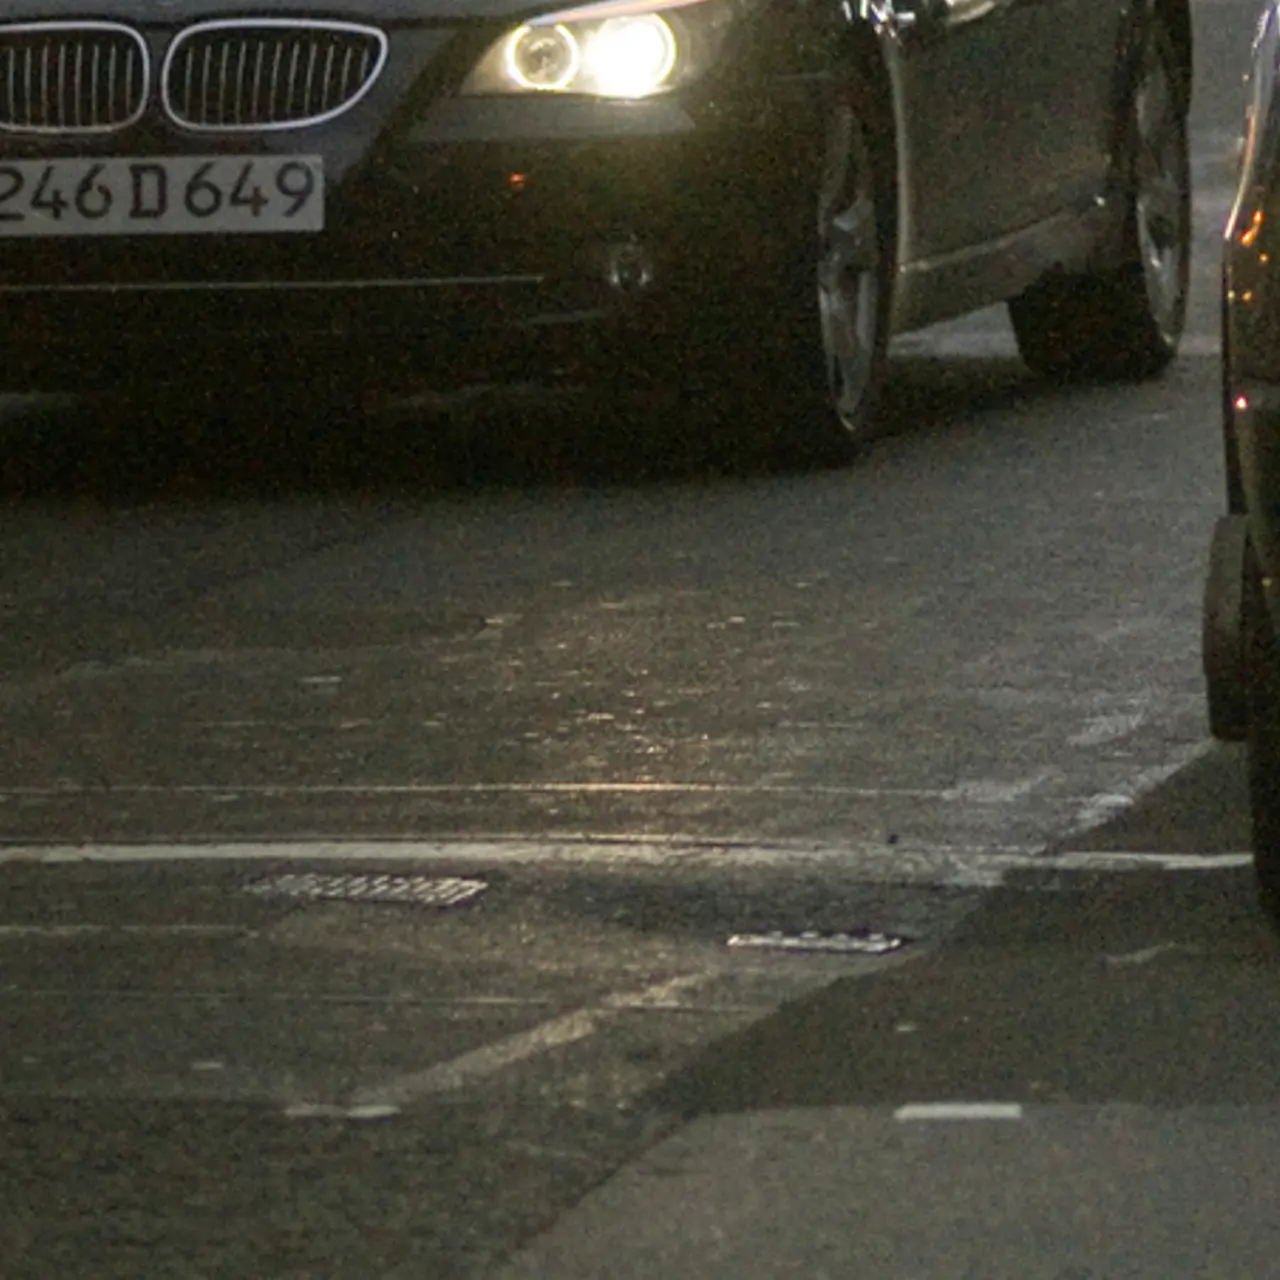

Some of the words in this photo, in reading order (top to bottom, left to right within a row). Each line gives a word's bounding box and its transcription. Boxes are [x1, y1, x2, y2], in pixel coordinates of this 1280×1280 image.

[0, 163, 113, 221] 246
[128, 163, 168, 219] D
[184, 160, 316, 218] 649
